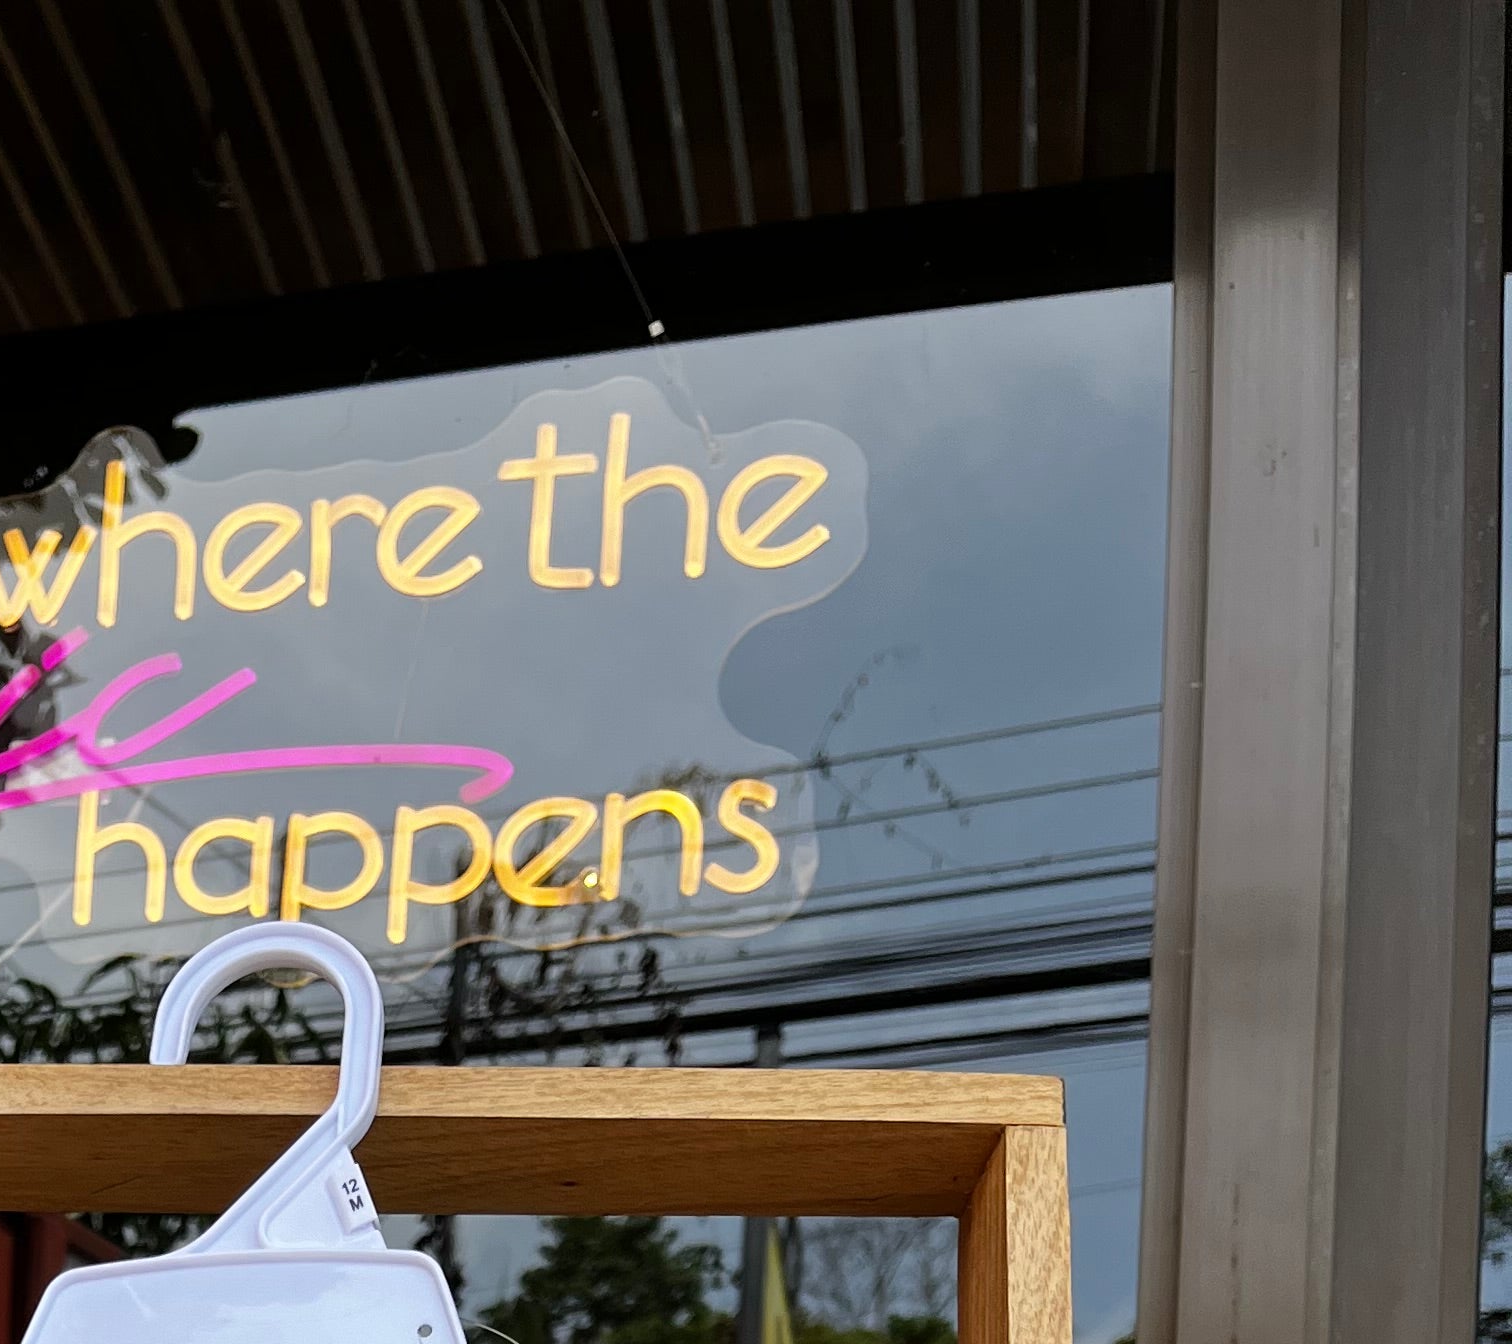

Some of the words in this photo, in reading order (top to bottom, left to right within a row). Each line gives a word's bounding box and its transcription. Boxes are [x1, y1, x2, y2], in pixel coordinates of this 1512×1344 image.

[496, 412, 831, 590] the
[71, 776, 782, 946] happens
[342, 1178, 360, 1195] 12
[349, 1196, 364, 1212] M
